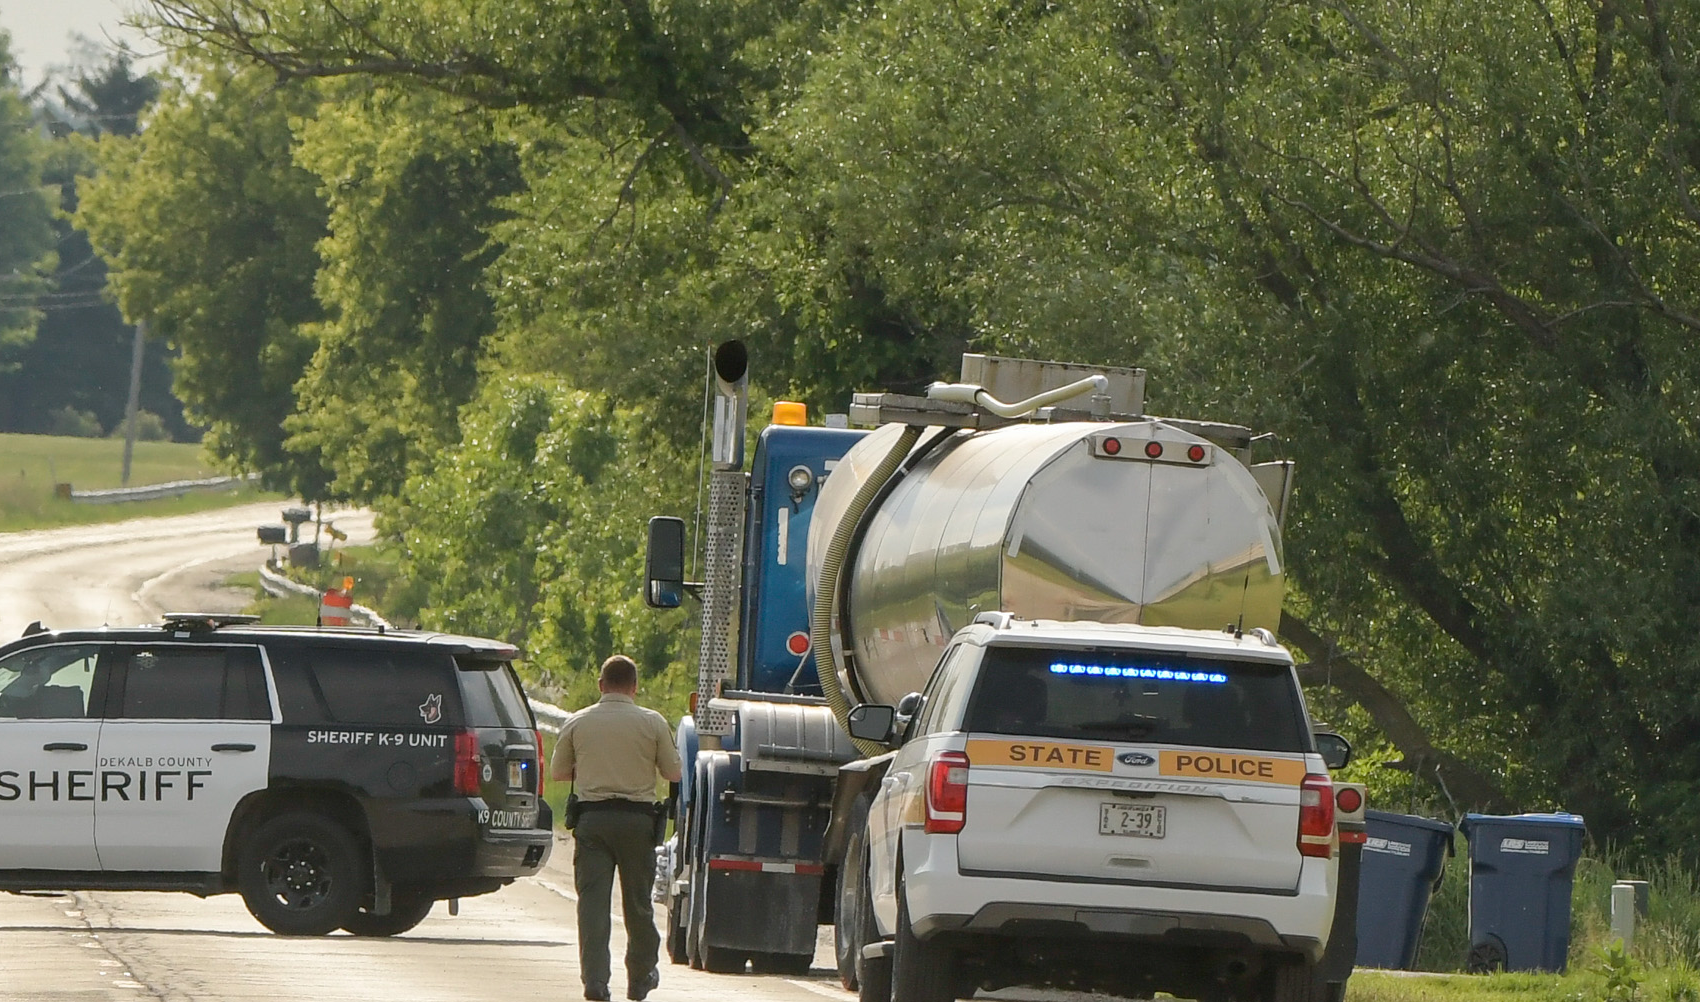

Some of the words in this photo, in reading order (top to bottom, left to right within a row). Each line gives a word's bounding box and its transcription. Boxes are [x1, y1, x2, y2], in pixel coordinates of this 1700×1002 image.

[307, 730, 375, 745] SHERIFF
[378, 732, 404, 746] K-9
[408, 733, 448, 748] UNIT
[100, 757, 153, 768] DEKALB
[158, 757, 213, 768] COUNTY
[1009, 744, 1102, 767] STATE
[1176, 754, 1275, 778] POLICE
[1124, 755, 1149, 765] Ford
[1061, 777, 1208, 793] EXPEDITION
[477, 809, 491, 825] K9
[1121, 811, 1152, 829] 2-39
